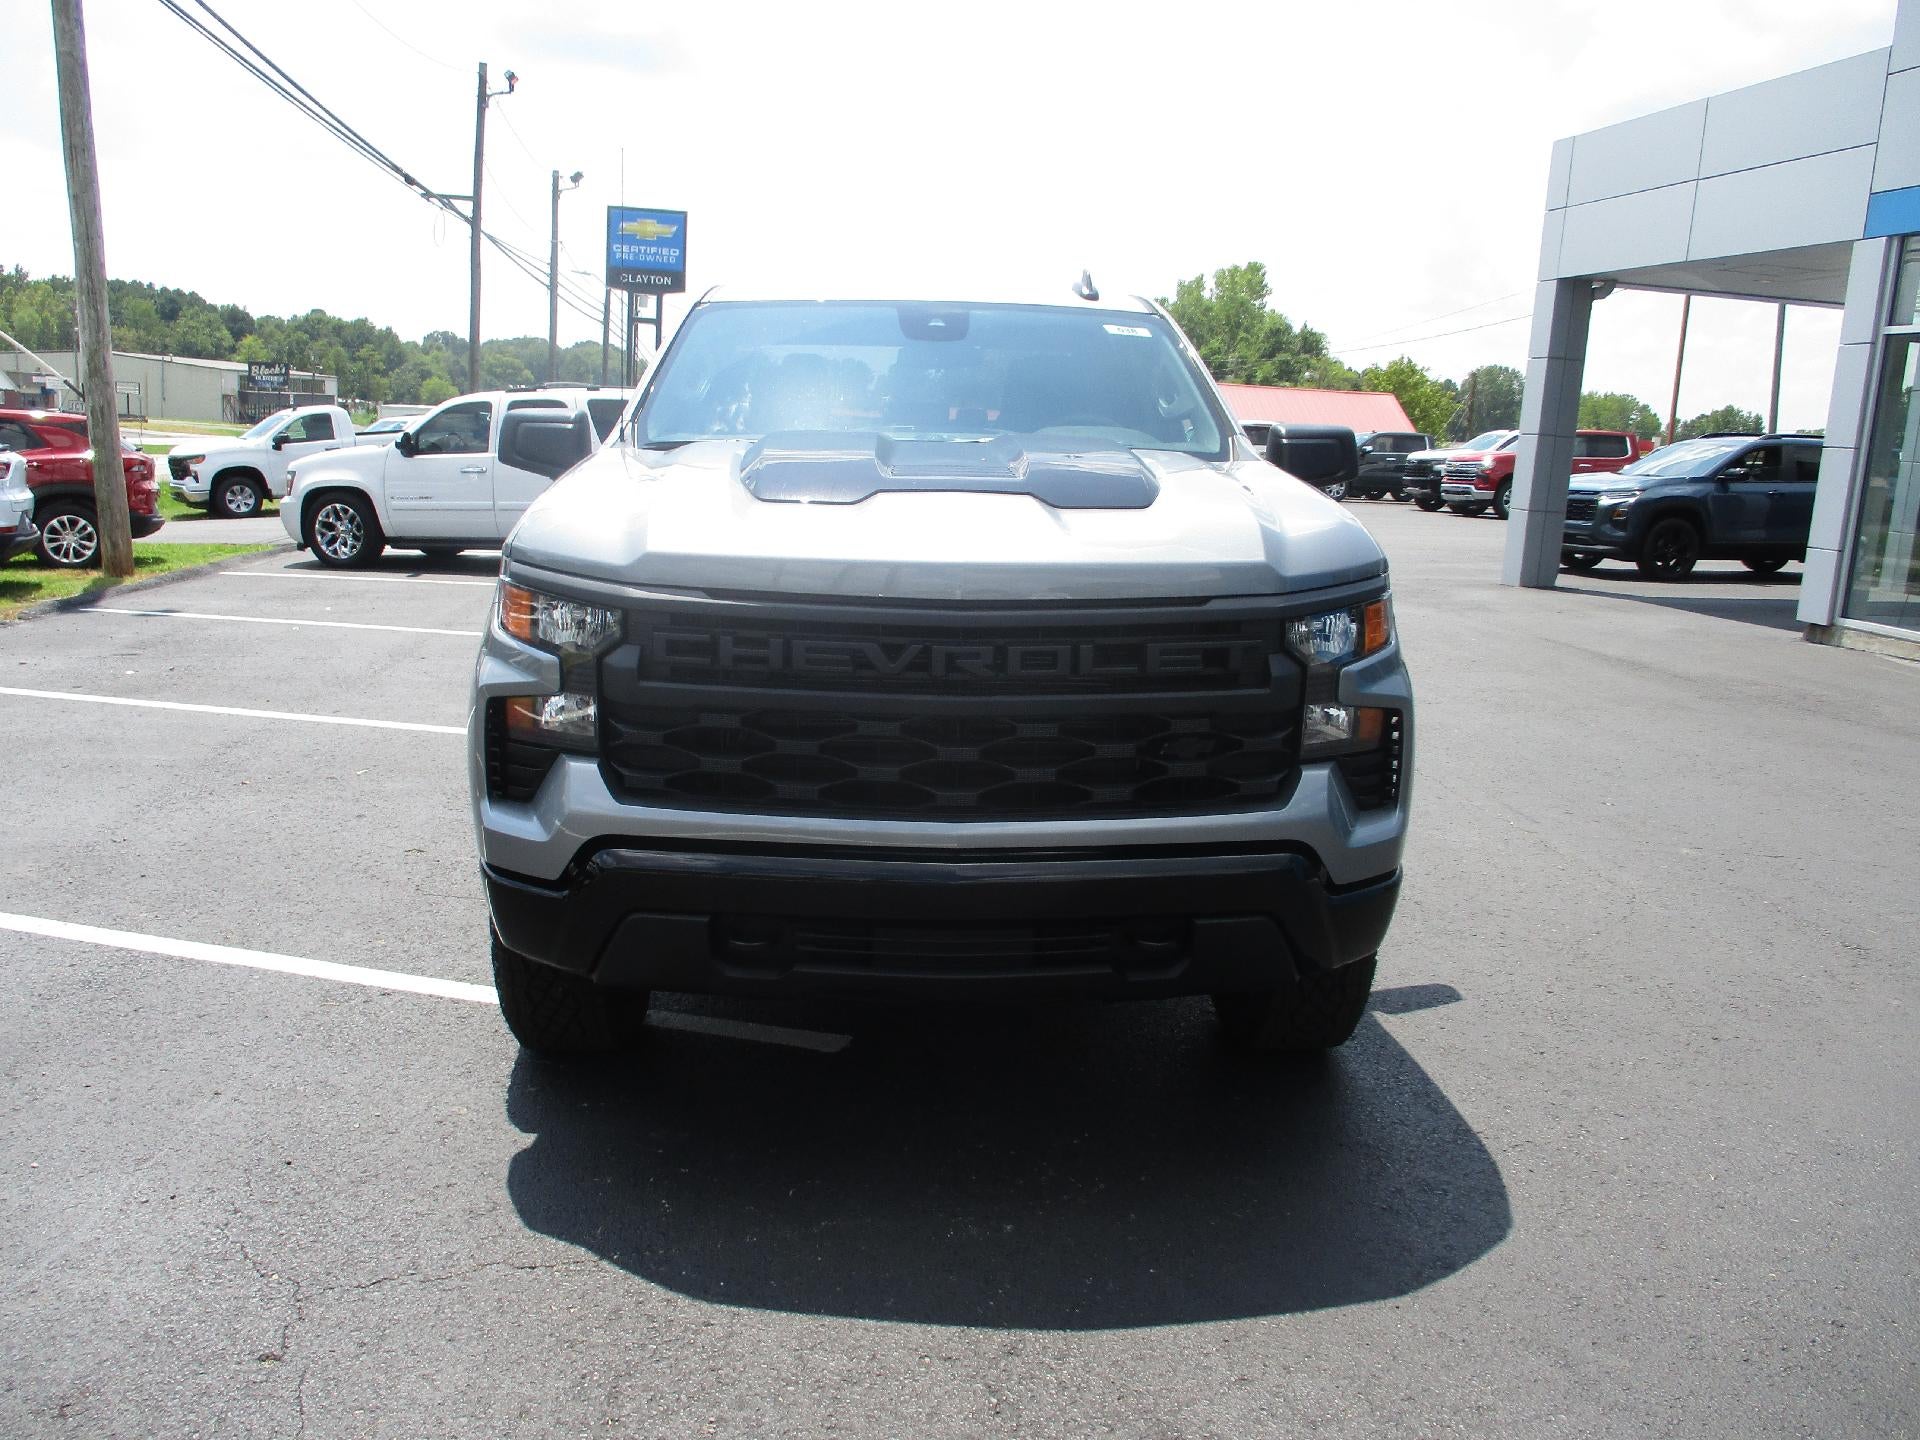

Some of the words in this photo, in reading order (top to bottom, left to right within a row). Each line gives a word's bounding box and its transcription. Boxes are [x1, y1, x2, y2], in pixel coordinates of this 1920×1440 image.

[613, 244, 680, 257] CERTIFIED
[620, 273, 672, 285] CLAYTON
[652, 631, 1264, 677] CHEVROLET
